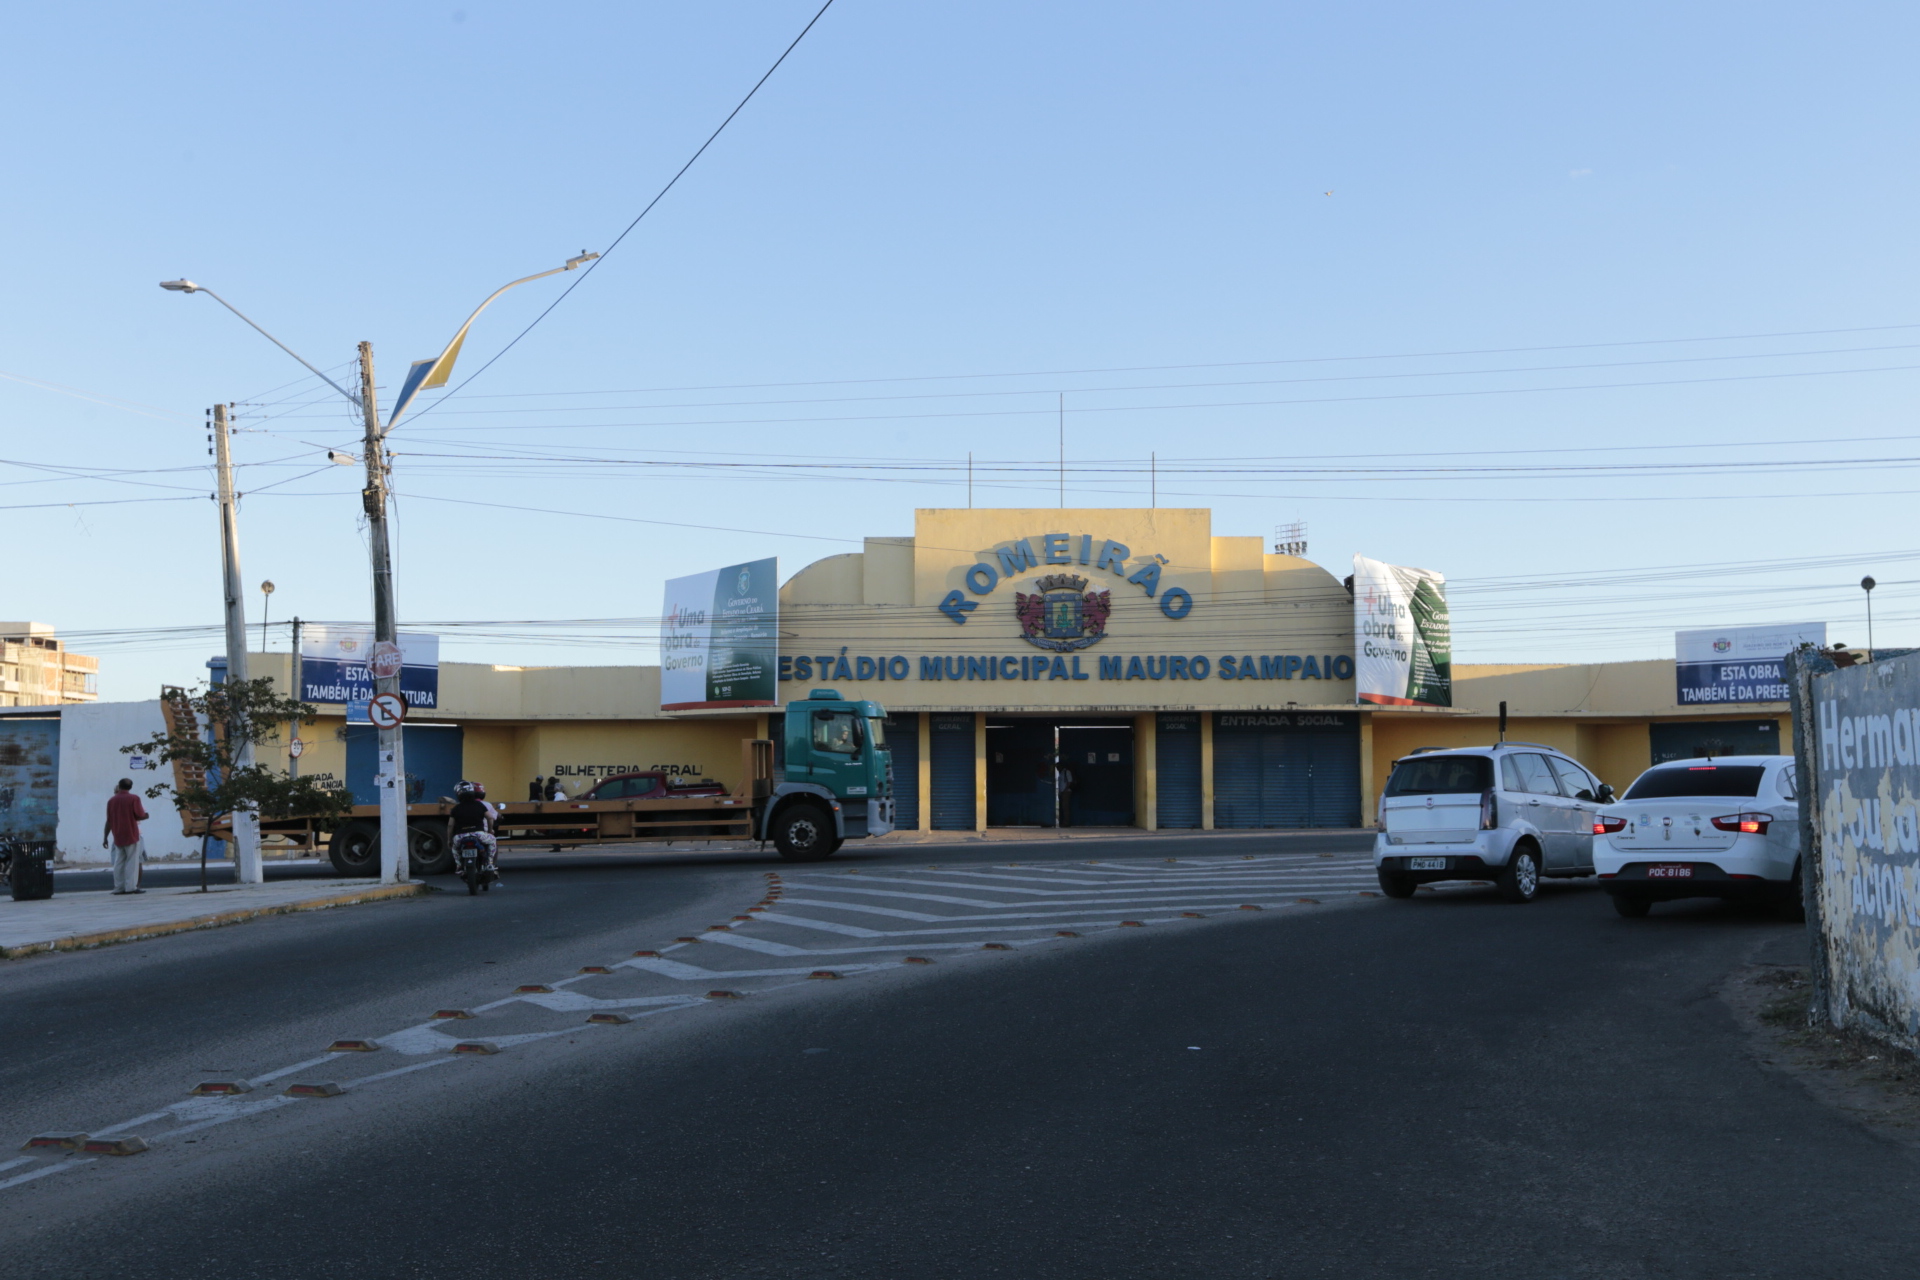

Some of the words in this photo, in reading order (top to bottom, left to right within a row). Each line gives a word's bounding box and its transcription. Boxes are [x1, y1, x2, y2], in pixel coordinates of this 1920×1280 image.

[938, 533, 1193, 625] ROMEIRÃO
[1363, 612, 1396, 640] obra
[665, 627, 693, 652] obra
[1364, 641, 1407, 662] Governo
[665, 654, 704, 671] Governo
[778, 646, 911, 681] ESTÁDIO
[920, 654, 1089, 681] MUNICIPAL
[1099, 654, 1211, 681] MAURO
[1218, 654, 1355, 681] SAMPAIO
[1720, 666, 1746, 681] ESTA
[1749, 664, 1781, 680] OBRA
[346, 667, 369, 681] ESTA
[306, 682, 350, 701] TAMBÉM
[352, 683, 358, 701] É
[360, 687, 375, 702] DA
[401, 689, 434, 705] ITURA
[1682, 682, 1726, 702] TAMBÉM
[1729, 682, 1736, 700] É
[1738, 685, 1753, 700] DA
[1756, 683, 1790, 699] PREFE
[1220, 715, 1291, 727] ENTRADA
[1297, 715, 1345, 727] SOCIAL
[555, 765, 640, 777] BILHETERIA
